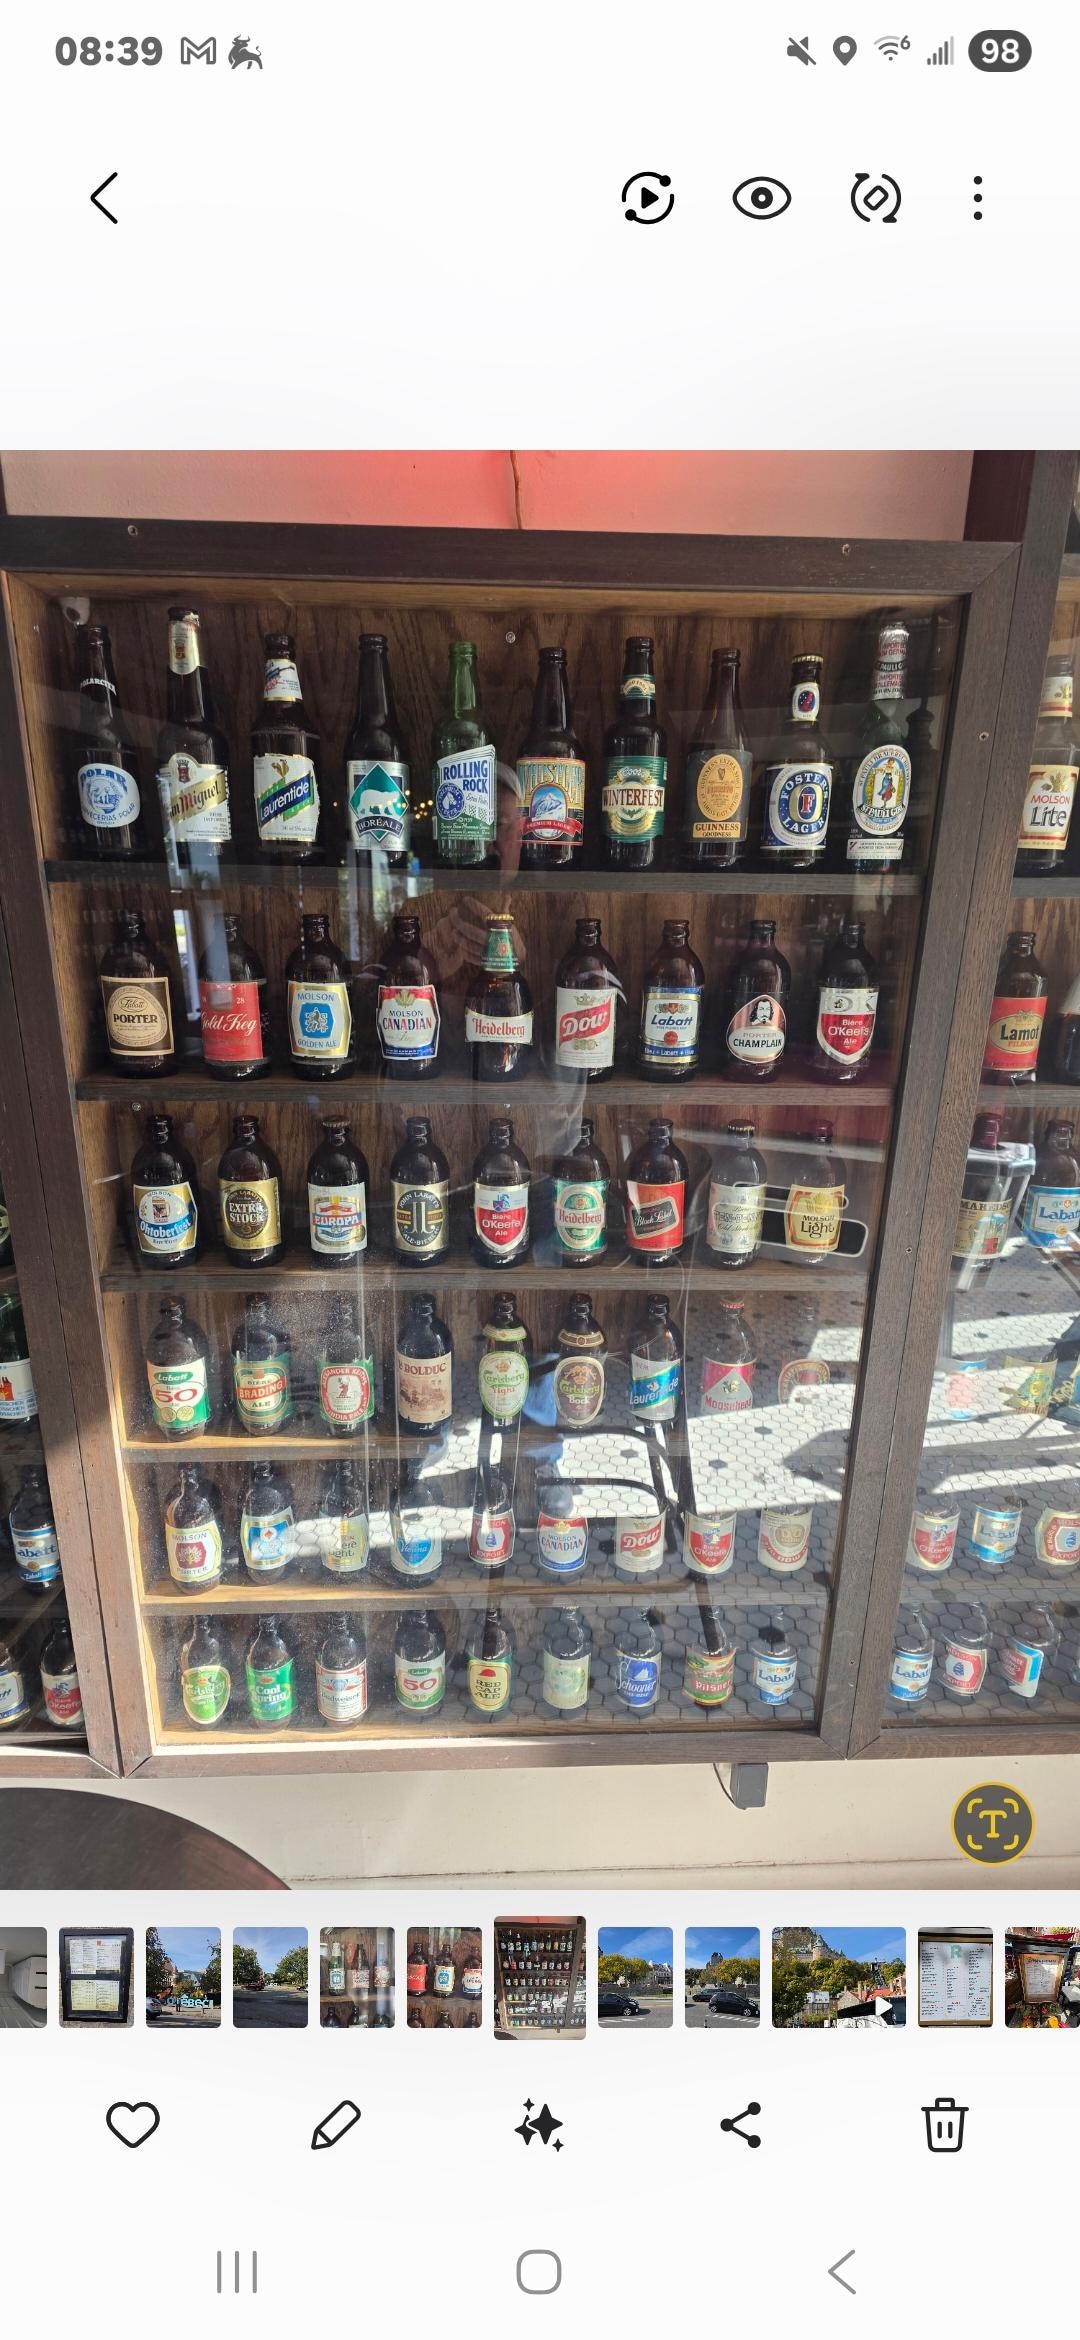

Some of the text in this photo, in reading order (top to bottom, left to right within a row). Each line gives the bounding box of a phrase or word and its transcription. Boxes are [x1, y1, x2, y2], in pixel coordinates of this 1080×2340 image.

[443, 759, 488, 780] ROLLING
[462, 778, 488, 793] ROCK
[780, 773, 829, 800] FOSTER'S
[179, 780, 220, 815] Miguel
[260, 781, 311, 821] Laurentide
[602, 788, 664, 807] WINTERFEST
[800, 793, 816, 813] F
[1030, 794, 1071, 804] MOLSON
[868, 805, 891, 818] PAULI
[1029, 806, 1067, 828] Lite
[357, 817, 402, 832] BORÉALE
[695, 823, 740, 832] GUINNESS
[782, 816, 825, 834] LAGER
[297, 992, 335, 1002] MOLSON
[113, 1013, 159, 1024] PORTER
[389, 1009, 424, 1018] MOLSON
[650, 1014, 694, 1026] Labatt
[222, 1013, 258, 1037] Keg
[382, 1017, 433, 1031] CANADIAN
[472, 1017, 525, 1038] Heidelberg
[561, 1012, 608, 1037] Dow
[1000, 1023, 1040, 1042] Lamot
[297, 1038, 338, 1048] GOLDEN ALE
[732, 1038, 783, 1049] CHAMPLAIN
[843, 1037, 858, 1045] Ale
[229, 1202, 265, 1213] EXTRA
[399, 1193, 413, 1209] JOHN
[229, 1212, 264, 1223] STOCK
[314, 1214, 360, 1226] EUROPA
[559, 1208, 602, 1227] Heidelberg
[635, 1214, 655, 1226] Black
[655, 1208, 673, 1224] Label
[802, 1214, 835, 1222] MOLSON
[139, 1218, 192, 1239] Oktoberfest
[800, 1220, 835, 1239] Light
[403, 1361, 448, 1376] BOLDUC
[157, 1372, 188, 1382] Labatt
[155, 1388, 198, 1403] 50
[239, 1380, 284, 1398] BRADING
[629, 1377, 679, 1405] Laurende
[251, 1400, 271, 1408] ALE
[568, 1394, 590, 1404] Bock
[703, 1395, 753, 1410] Moosehead
[171, 1531, 208, 1541] MOLSON
[623, 1529, 662, 1548] Dow
[541, 1537, 584, 1551] CANADIAN
[616, 1658, 658, 1692] Schooner
[255, 1684, 282, 1695] Cool
[403, 1677, 438, 1691] 50
[474, 1685, 501, 1695] CAP
[475, 1679, 502, 1688] RED
[694, 1678, 733, 1693] Pilsner
[320, 1689, 361, 1702] Budweiser
[474, 1691, 502, 1700] ALE
